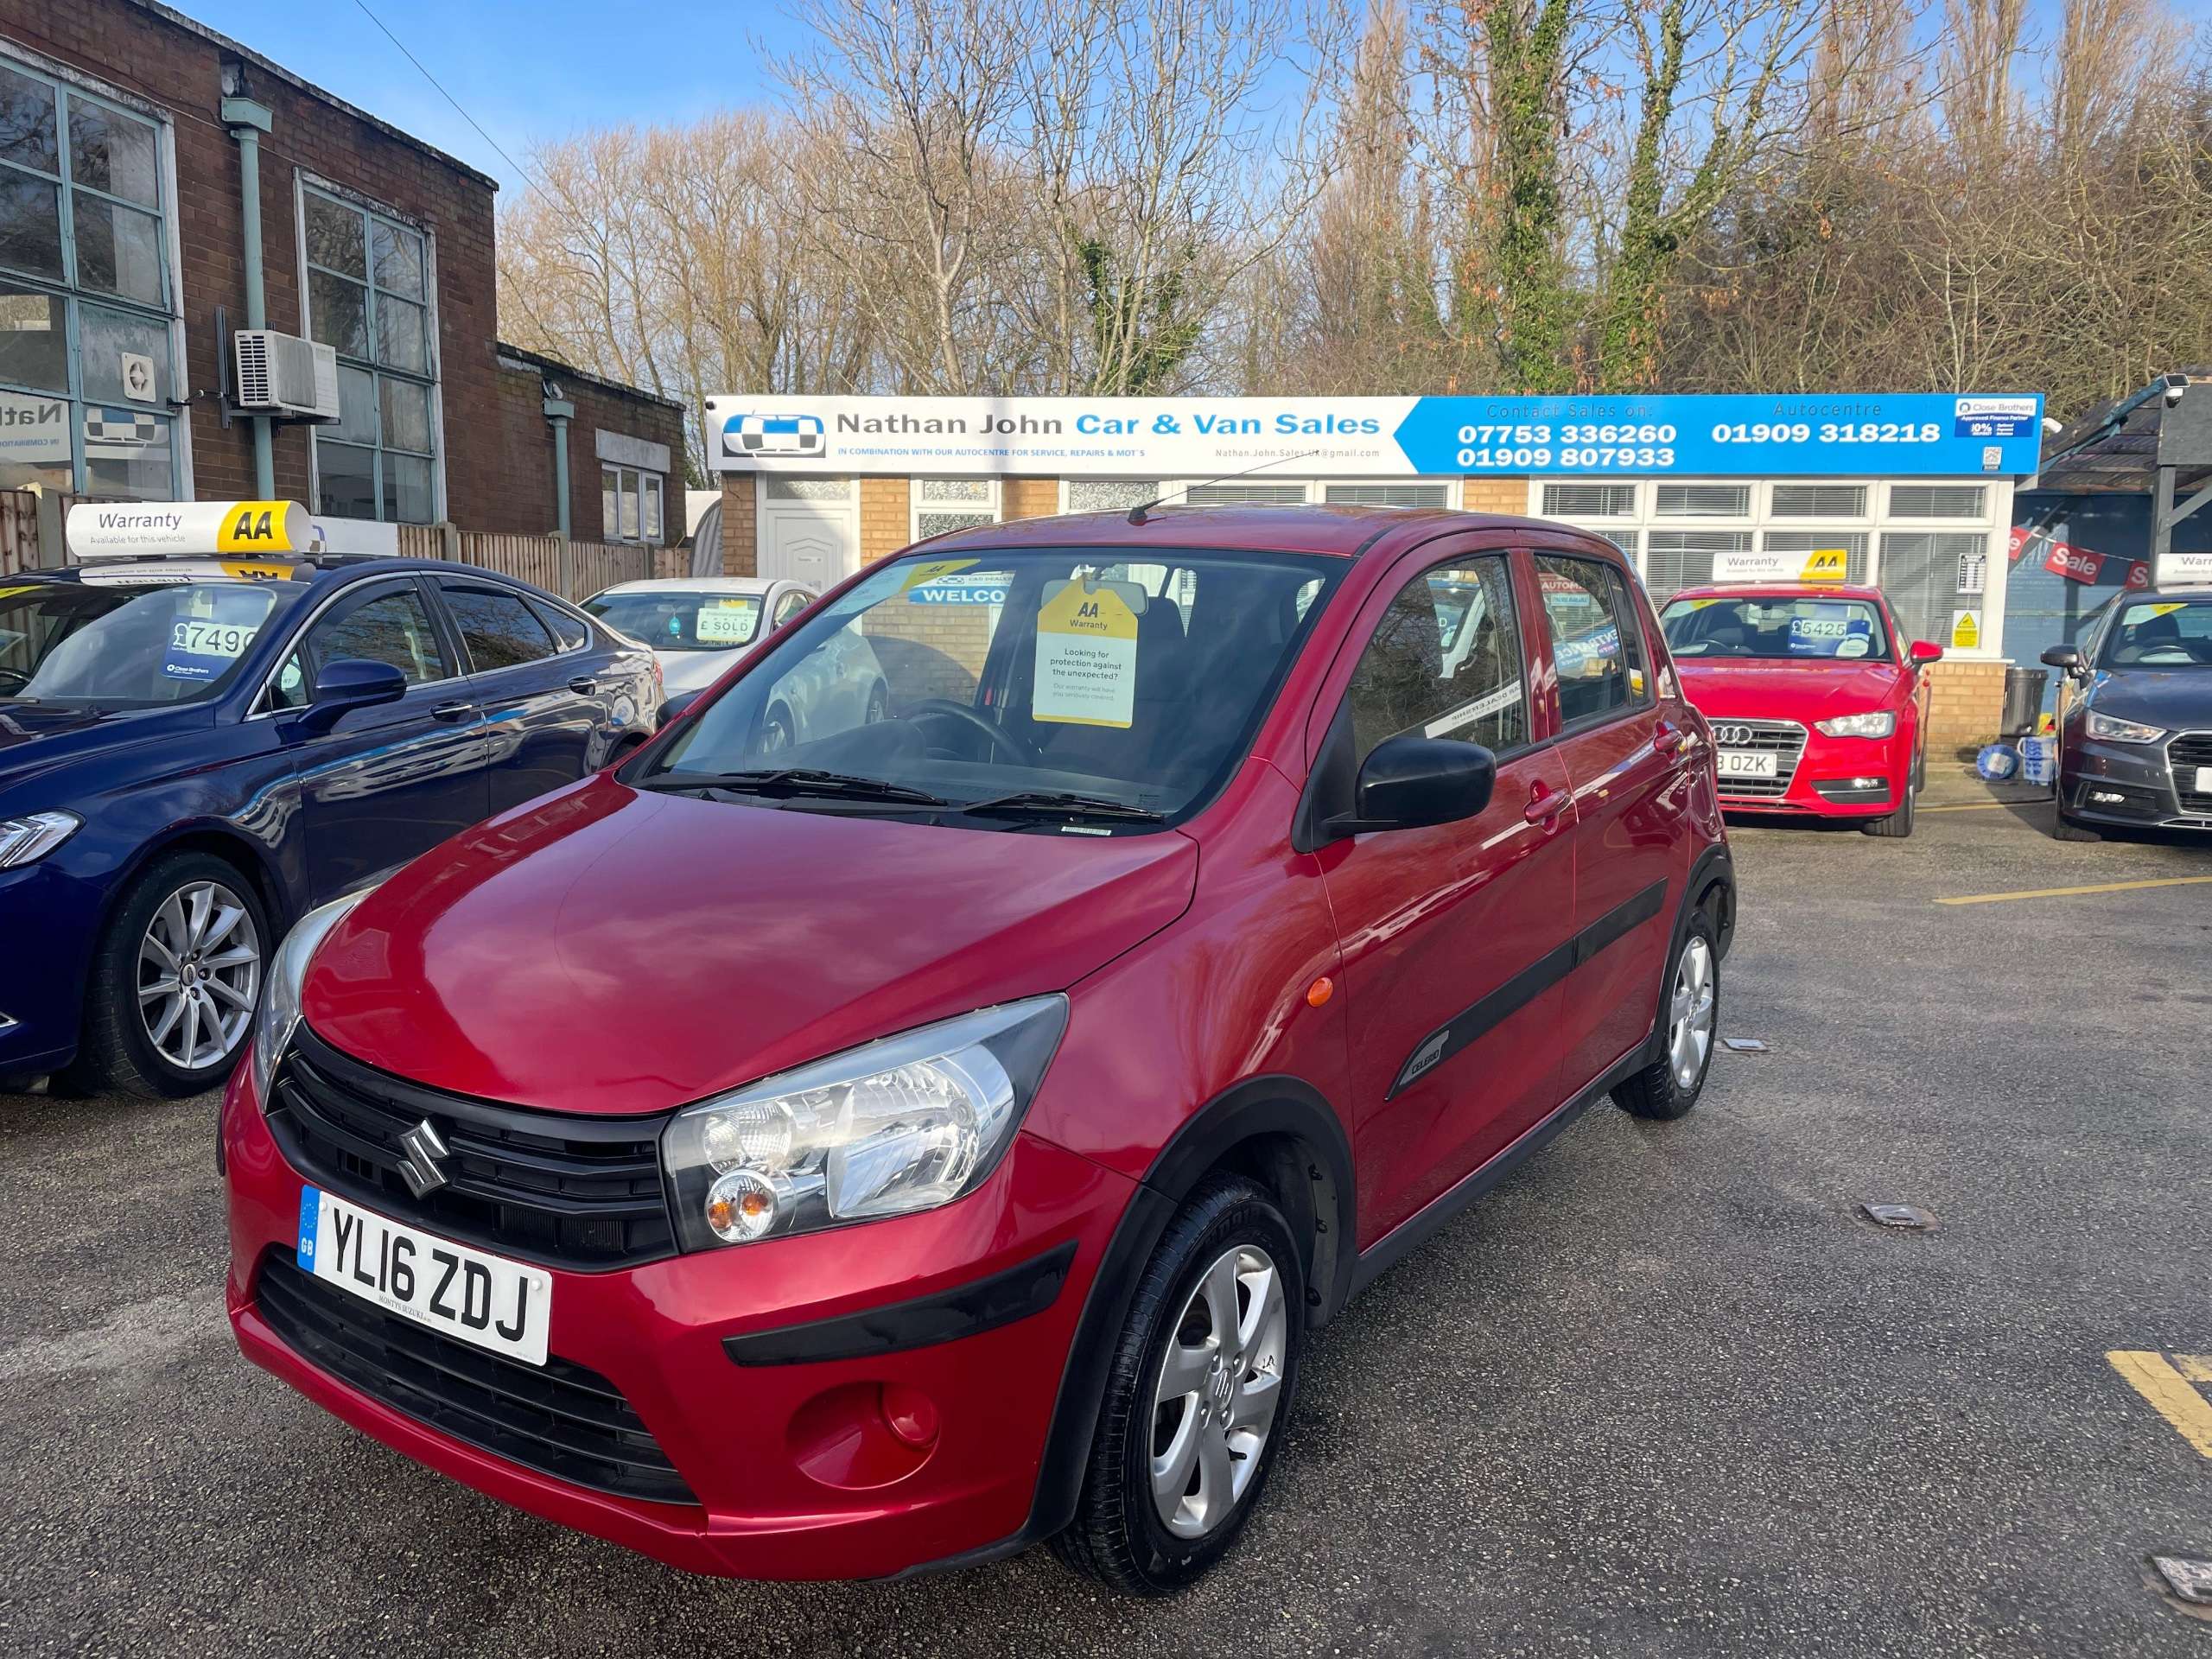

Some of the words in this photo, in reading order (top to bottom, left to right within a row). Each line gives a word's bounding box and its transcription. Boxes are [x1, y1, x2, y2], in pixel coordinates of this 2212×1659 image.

[1486, 404, 1560, 418] Contact
[1568, 404, 1616, 418] Sales
[1625, 405, 1653, 418] on:
[1774, 402, 1881, 416] Autocentre
[837, 414, 966, 434] Nathan
[980, 414, 1062, 434] John
[1076, 414, 1139, 435] Car
[1152, 414, 1181, 435] &
[1193, 414, 1261, 435] Van
[1274, 414, 1381, 435] Sales
[1971, 423, 1993, 432] 10%
[1458, 425, 1551, 443] 07753
[1560, 425, 1677, 443] 336260
[1711, 423, 1810, 442] 01909
[1819, 423, 1941, 442] 318218
[1457, 448, 1551, 467] 01909
[1560, 448, 1675, 467] 807933
[99, 512, 182, 531] Warranty
[232, 512, 274, 540] AA
[90, 536, 126, 544] Available
[128, 535, 139, 543] for
[157, 534, 186, 543] vehicle
[1728, 557, 1779, 567] Warranty
[1815, 556, 1838, 568] AA
[2052, 547, 2097, 575] Sale
[923, 589, 1006, 602] WELCO
[1077, 602, 1099, 619] AA
[714, 622, 748, 632] SOLD
[1070, 619, 1108, 631] Warranty
[1791, 620, 1847, 636] £5425
[1065, 648, 1096, 659] Looking
[1050, 658, 1091, 668] protection
[1093, 662, 1122, 671] against
[1067, 671, 1118, 681] unexpected?
[1731, 756, 1767, 772] OZK
[301, 1236, 314, 1257] GB
[334, 1207, 416, 1302] YL16
[429, 1248, 529, 1342] ZDJ
